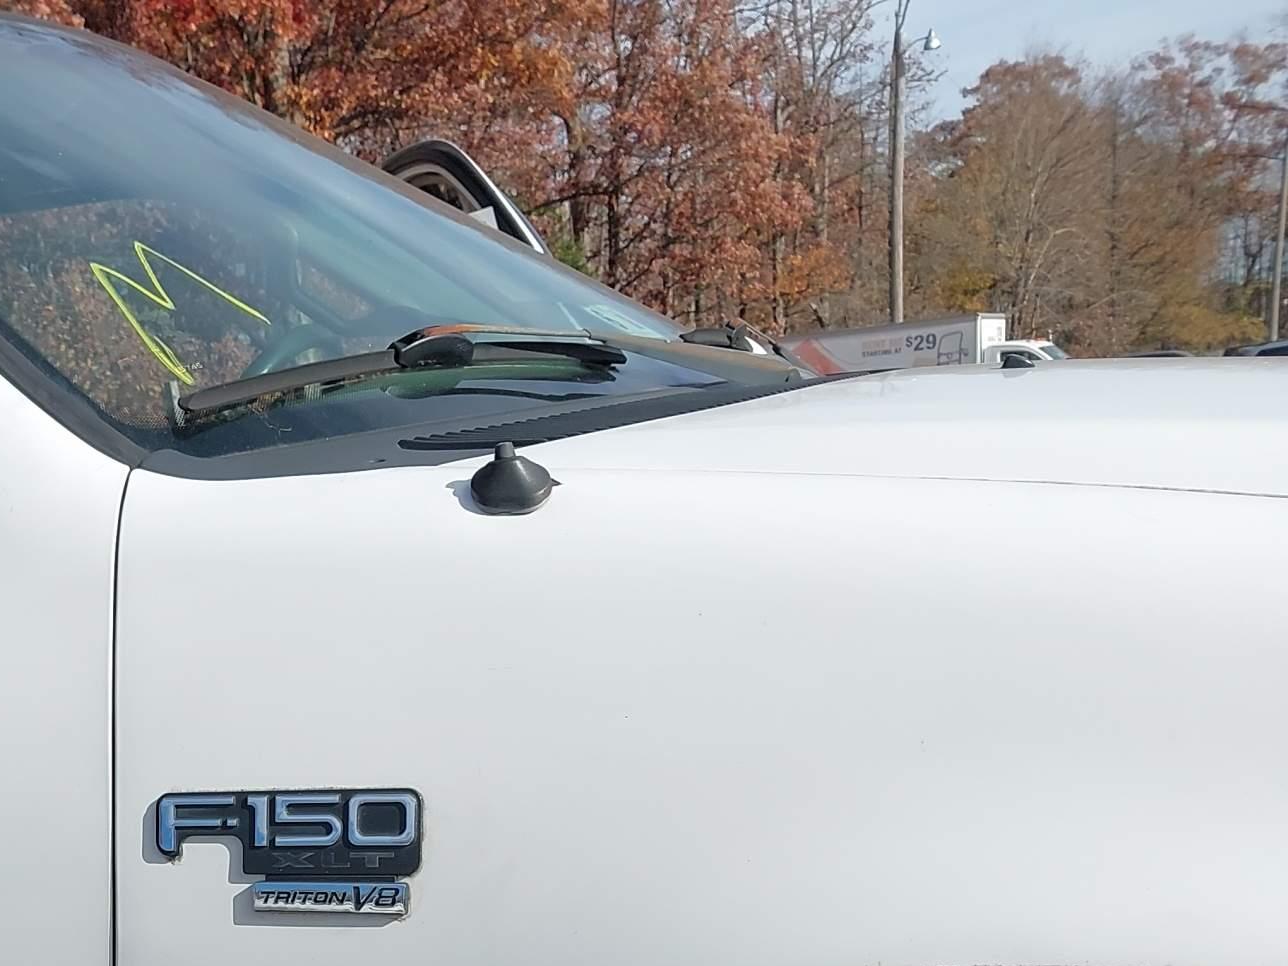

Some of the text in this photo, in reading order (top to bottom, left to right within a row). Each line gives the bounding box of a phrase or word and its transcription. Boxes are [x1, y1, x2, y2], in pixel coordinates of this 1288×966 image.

[90, 240, 272, 386] M
[905, 333, 937, 352] $29
[271, 851, 395, 868] XLT
[259, 885, 399, 912] TRITON V8
